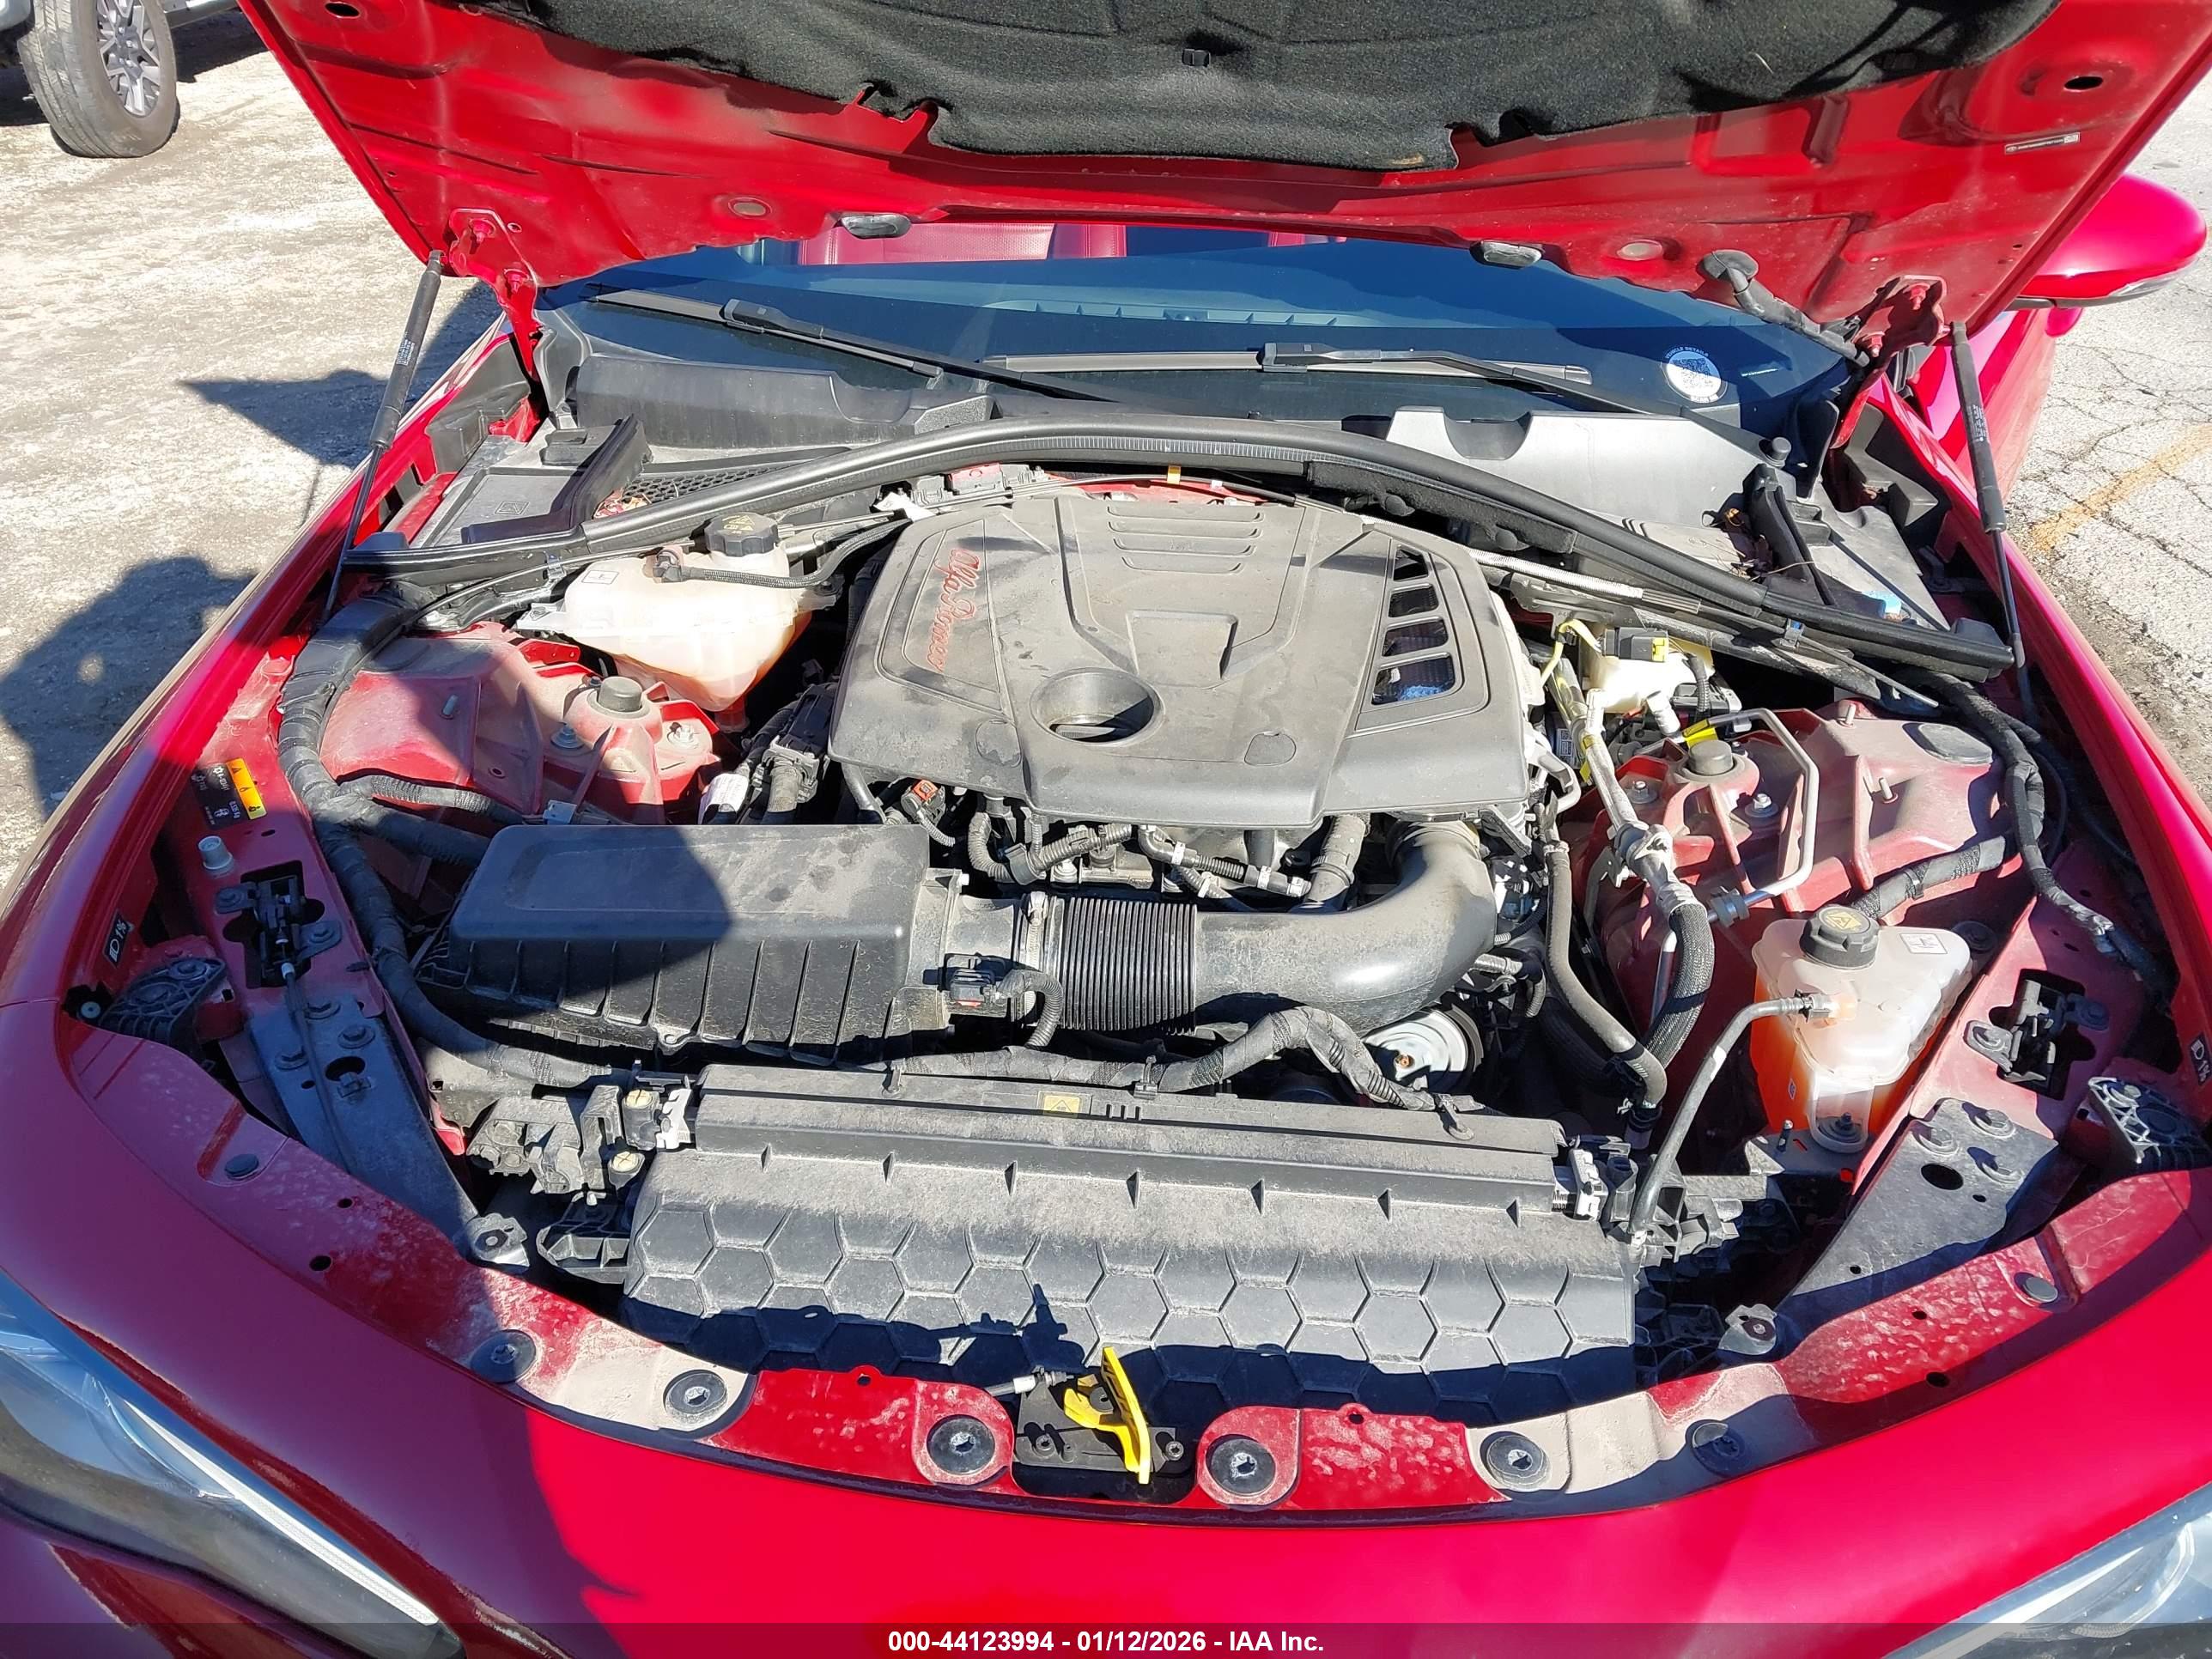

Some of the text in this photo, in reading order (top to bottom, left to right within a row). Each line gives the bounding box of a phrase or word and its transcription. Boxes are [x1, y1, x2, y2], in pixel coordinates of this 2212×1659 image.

[1665, 346, 1709, 358] VEHICLE DETAILS
[927, 549, 980, 672] Alfa Romeo
